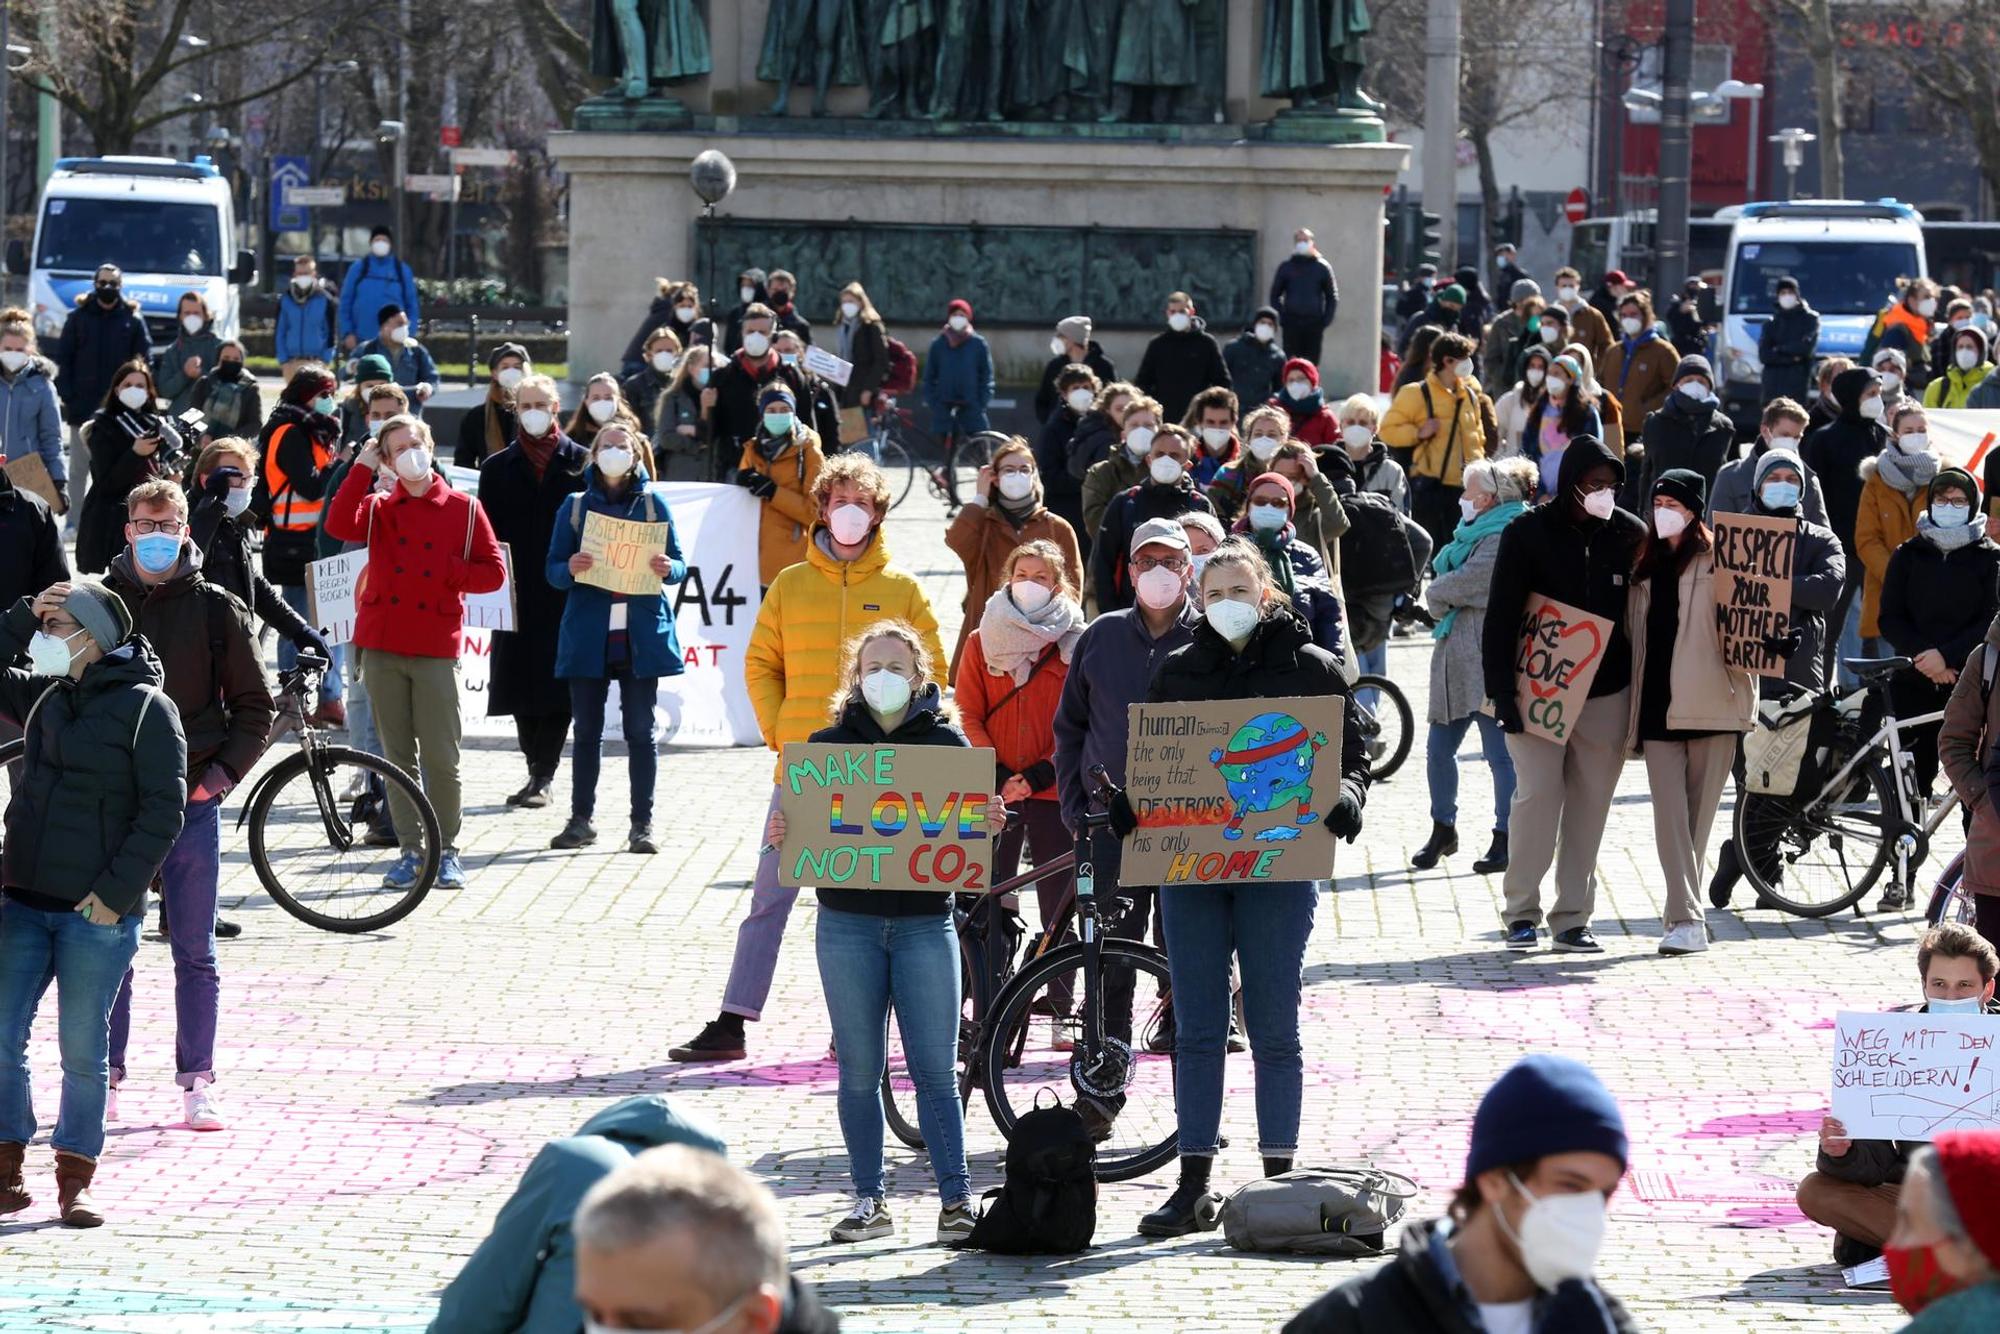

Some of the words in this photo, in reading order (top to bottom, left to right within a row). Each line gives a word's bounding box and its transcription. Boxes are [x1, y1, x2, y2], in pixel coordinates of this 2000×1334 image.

[319, 559, 350, 578] KEIN
[606, 543, 642, 571] NOT
[1714, 523, 1795, 580] RESPECT
[320, 587, 351, 603] BOGEN
[1730, 574, 1771, 608] YOUR
[1716, 602, 1789, 639] MOTHER
[1516, 644, 1575, 690] LOVE
[1723, 635, 1777, 670] EARTH
[1138, 708, 1196, 737] human
[1528, 697, 1567, 739] CO2
[1134, 740, 1153, 763] the
[1160, 741, 1185, 763] only
[788, 748, 896, 795] MAKE
[1132, 767, 1162, 794] being
[1168, 763, 1200, 785] that
[830, 791, 989, 840] LOVE
[1137, 796, 1226, 818] DESTROYS
[1132, 829, 1151, 853] his
[1161, 830, 1190, 853] only
[793, 845, 894, 883] NOT
[908, 843, 984, 889] CO2
[1164, 849, 1285, 883] HOME
[1840, 1027, 1889, 1050] WEG
[1959, 1032, 1995, 1050] DEN
